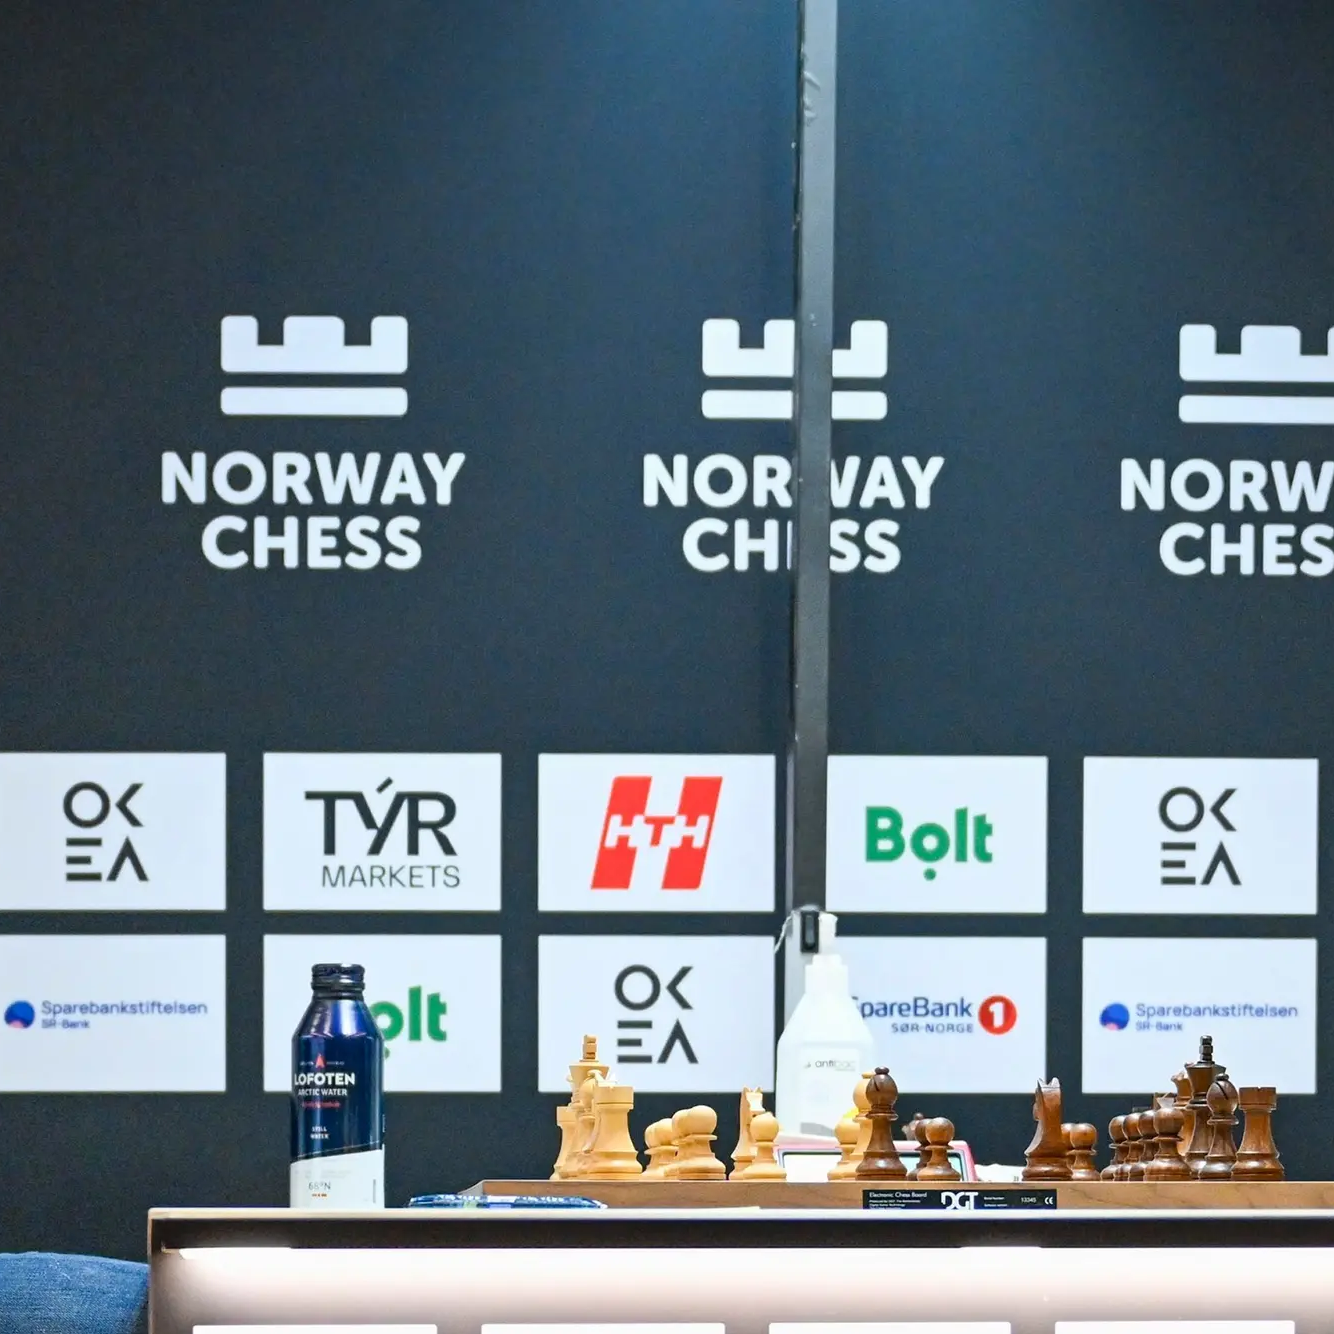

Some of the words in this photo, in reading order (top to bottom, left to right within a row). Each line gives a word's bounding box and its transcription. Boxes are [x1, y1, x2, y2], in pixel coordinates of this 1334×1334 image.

[162, 451, 465, 505] NORWAY
[202, 516, 421, 570] CHESS
[683, 518, 901, 573] CHSS
[63, 782, 143, 828] OK
[1159, 787, 1236, 832] OK
[66, 837, 148, 881] EA
[866, 807, 992, 880] Bolt
[1161, 842, 1241, 885] EA
[322, 865, 460, 888] MARKETS
[41, 1000, 208, 1019] Sparebankstiftelsen
[615, 965, 692, 1010] OK
[851, 995, 973, 1020] pareBank
[368, 985, 447, 1060] olt
[1136, 1002, 1298, 1020] Sparebankstiftelsen
[617, 1019, 698, 1064] EA
[294, 1072, 356, 1086] LOFOTEN
[321, 1088, 348, 1096] WATER
[941, 1191, 979, 1210] DGT
